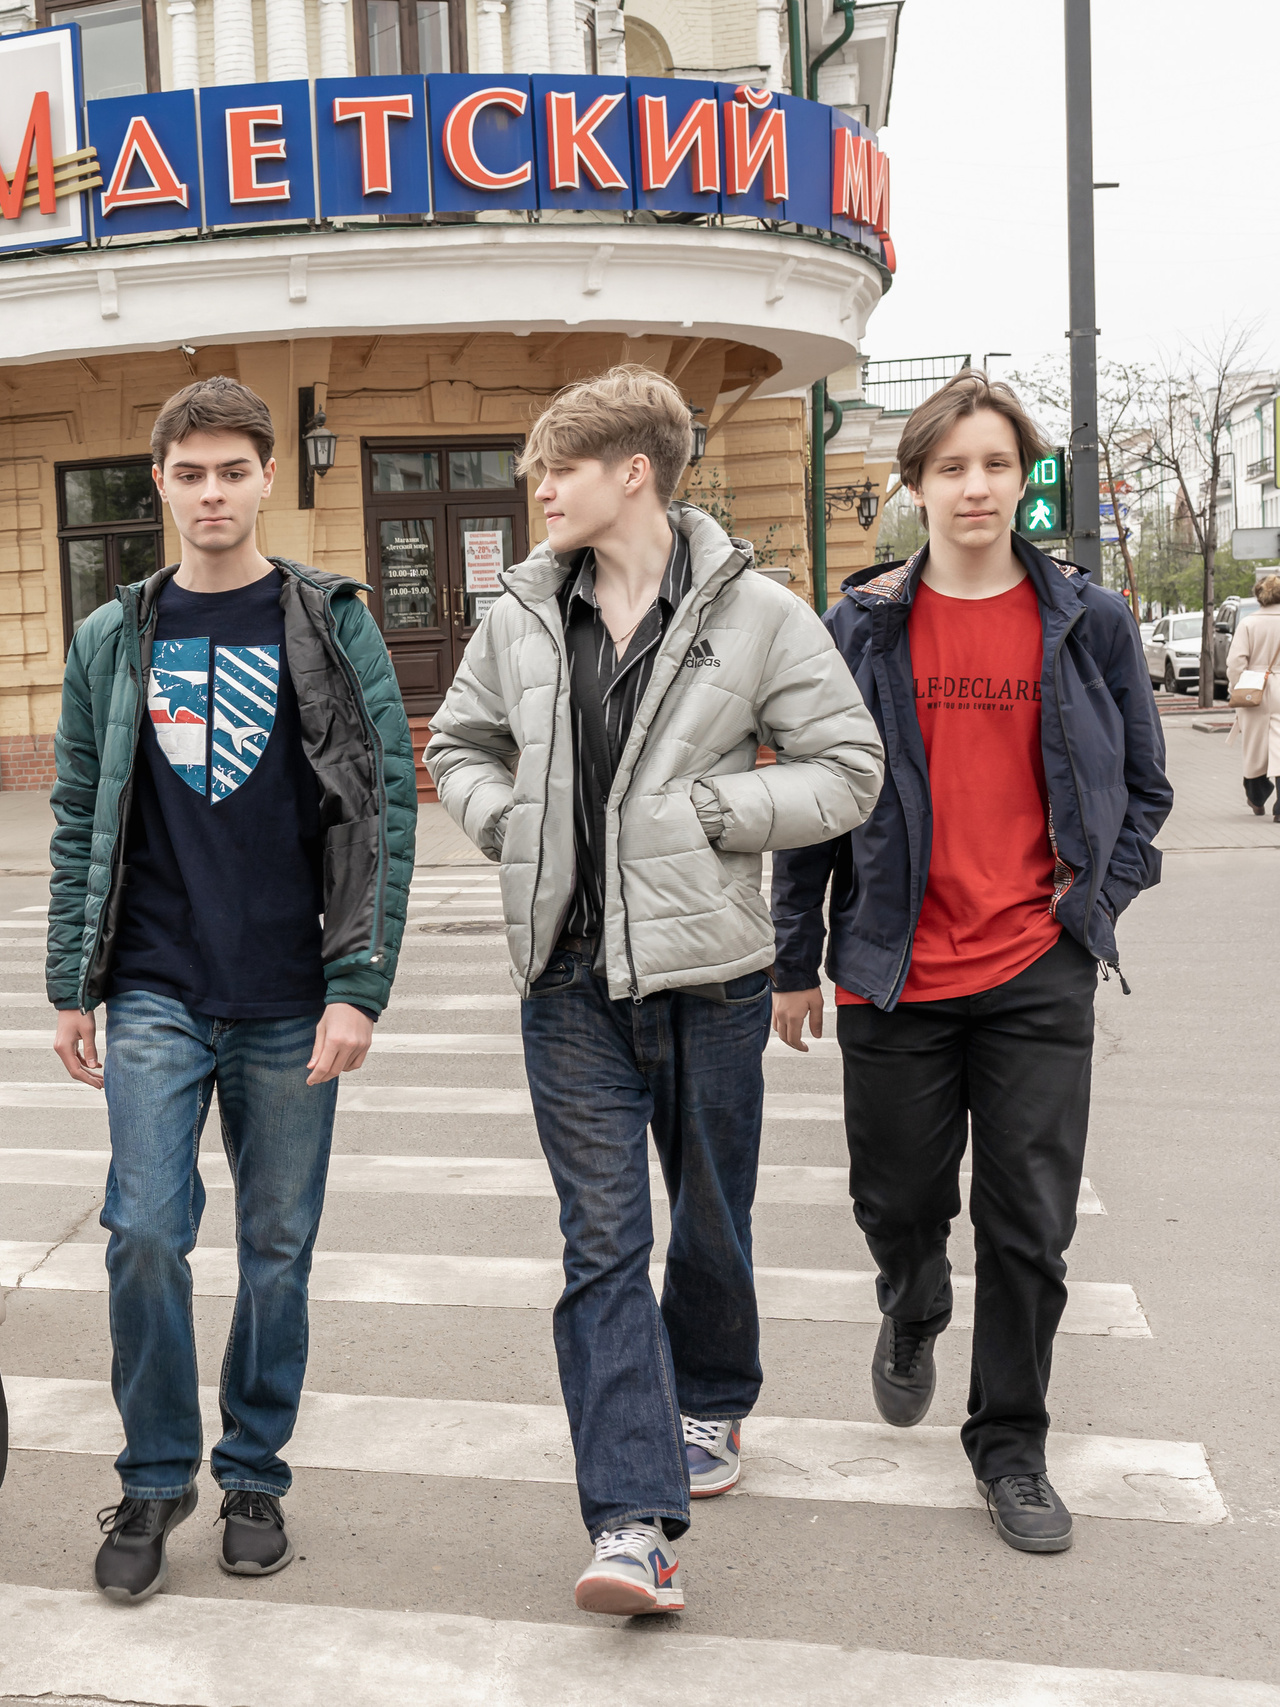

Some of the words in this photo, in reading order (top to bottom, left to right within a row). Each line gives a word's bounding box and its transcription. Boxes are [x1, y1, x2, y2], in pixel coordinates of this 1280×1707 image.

[101, 85, 789, 219] ДЕТСКИЙ
[832, 126, 896, 274] МИ
[1028, 458, 1056, 484] 10
[973, 702, 996, 711] EVERY
[999, 703, 1015, 712] DAY
